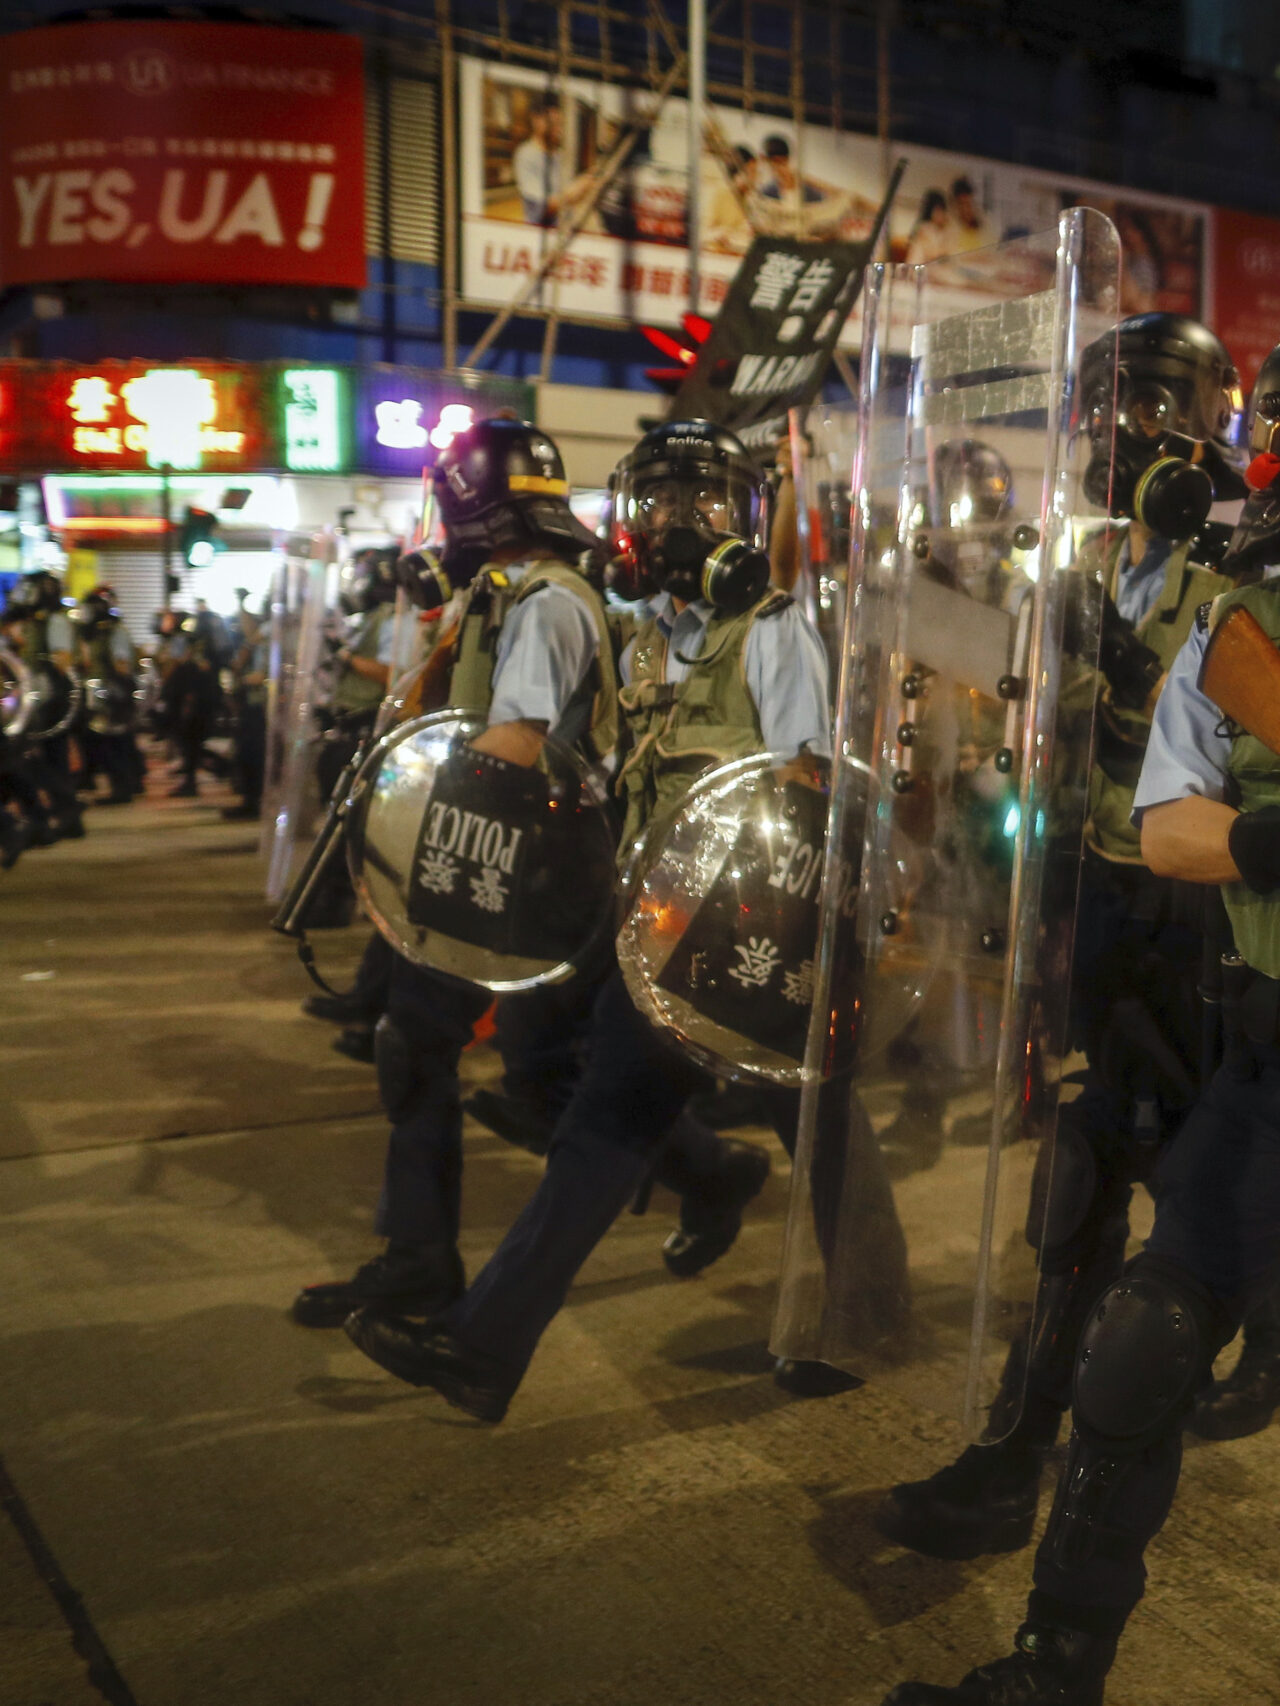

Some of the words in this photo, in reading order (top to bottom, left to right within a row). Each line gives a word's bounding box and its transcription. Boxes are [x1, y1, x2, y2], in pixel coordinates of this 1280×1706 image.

[749, 251, 836, 312] 警告
[423, 800, 523, 875] POLICE
[418, 849, 510, 914] 警察
